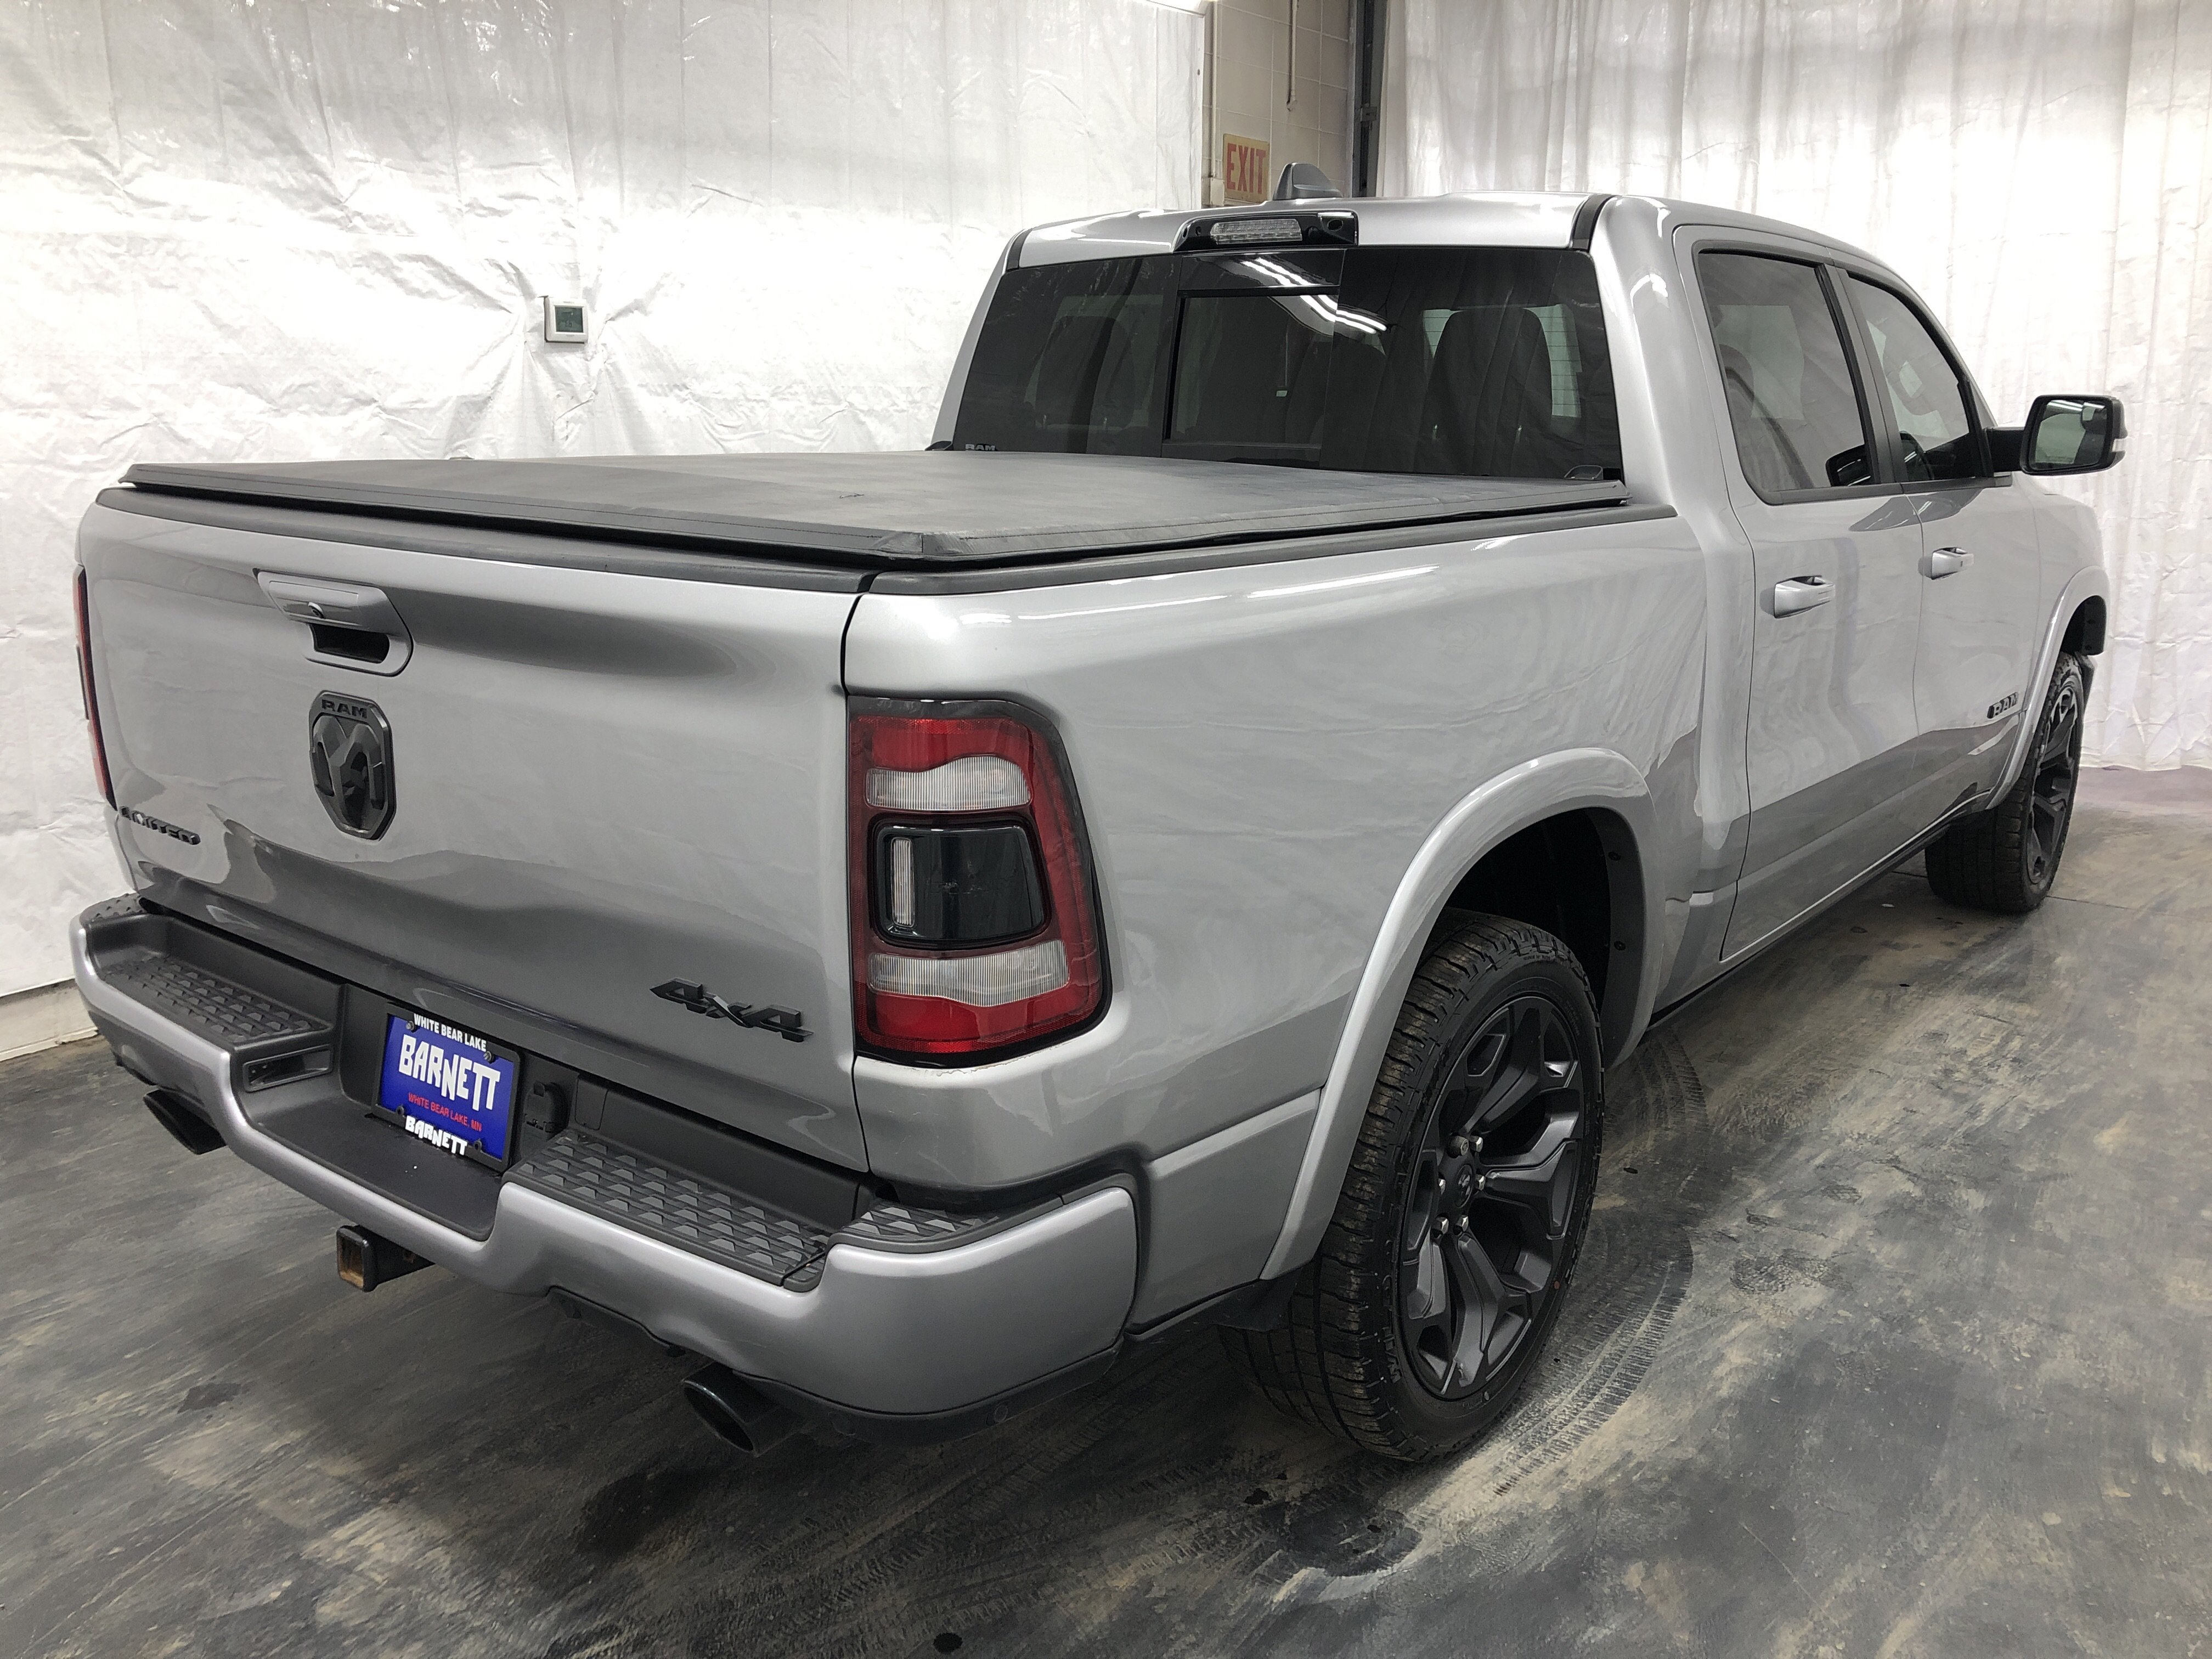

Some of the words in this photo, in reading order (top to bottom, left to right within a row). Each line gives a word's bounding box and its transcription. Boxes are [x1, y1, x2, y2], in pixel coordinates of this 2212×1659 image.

[1226, 143, 1266, 194] EXIT
[321, 698, 368, 719] RAM
[414, 1013, 439, 1034] WHITE
[441, 1024, 463, 1044] BEAR
[464, 1032, 487, 1052] LAKE
[398, 1034, 501, 1111] BARNETT
[408, 1092, 430, 1110] WHITE
[430, 1101, 449, 1118] BEAR
[471, 1120, 482, 1132] MN
[405, 1115, 467, 1156] BARNETT
